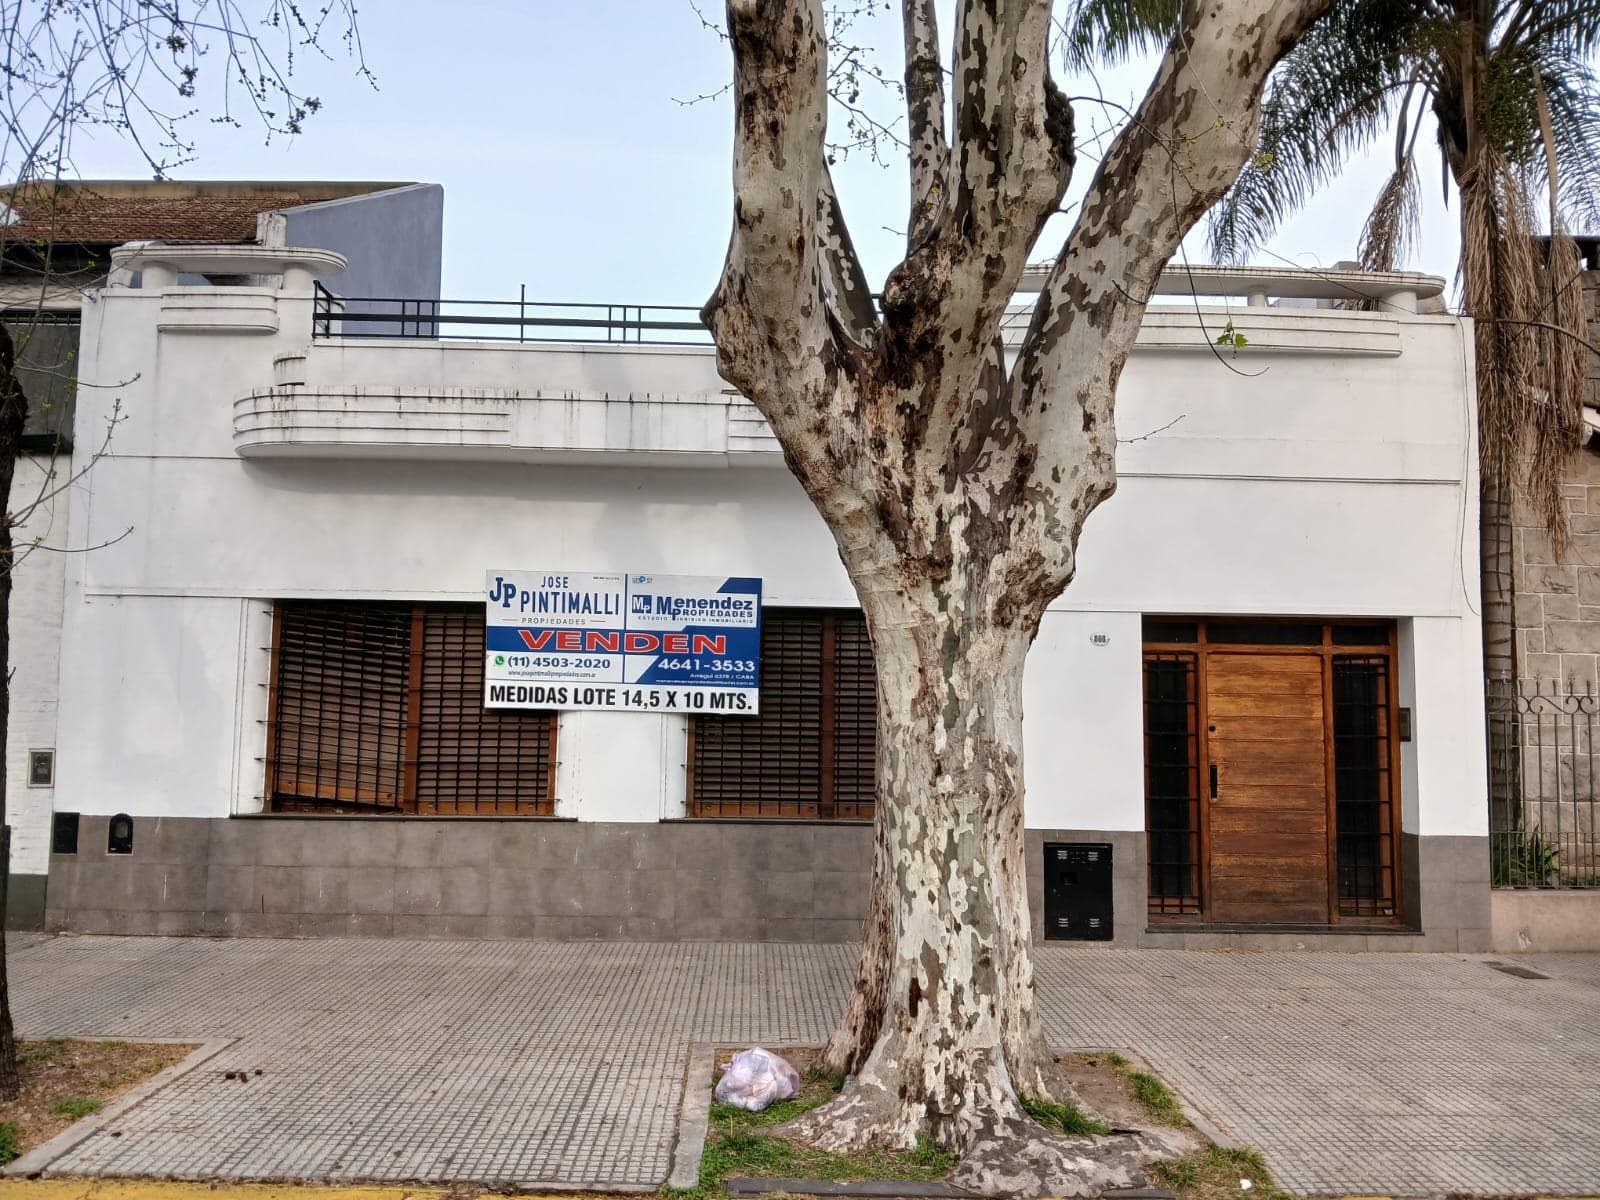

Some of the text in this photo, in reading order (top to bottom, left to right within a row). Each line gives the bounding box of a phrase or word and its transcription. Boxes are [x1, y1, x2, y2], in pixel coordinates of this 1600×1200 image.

[541, 576, 569, 589] JOSE
[489, 577, 517, 608] JP
[520, 590, 620, 615] PINTIMALLI
[656, 596, 753, 615] Menendez
[522, 617, 586, 625] PROPIEDADES
[672, 608, 753, 621] PROPIEDADES
[518, 629, 726, 655] VENDEN
[508, 656, 611, 669] (11) 4503-2020
[658, 658, 755, 672] 4641-3533
[490, 685, 752, 710] MEDIDAS LOTE 14,5 X 10 MTS.
